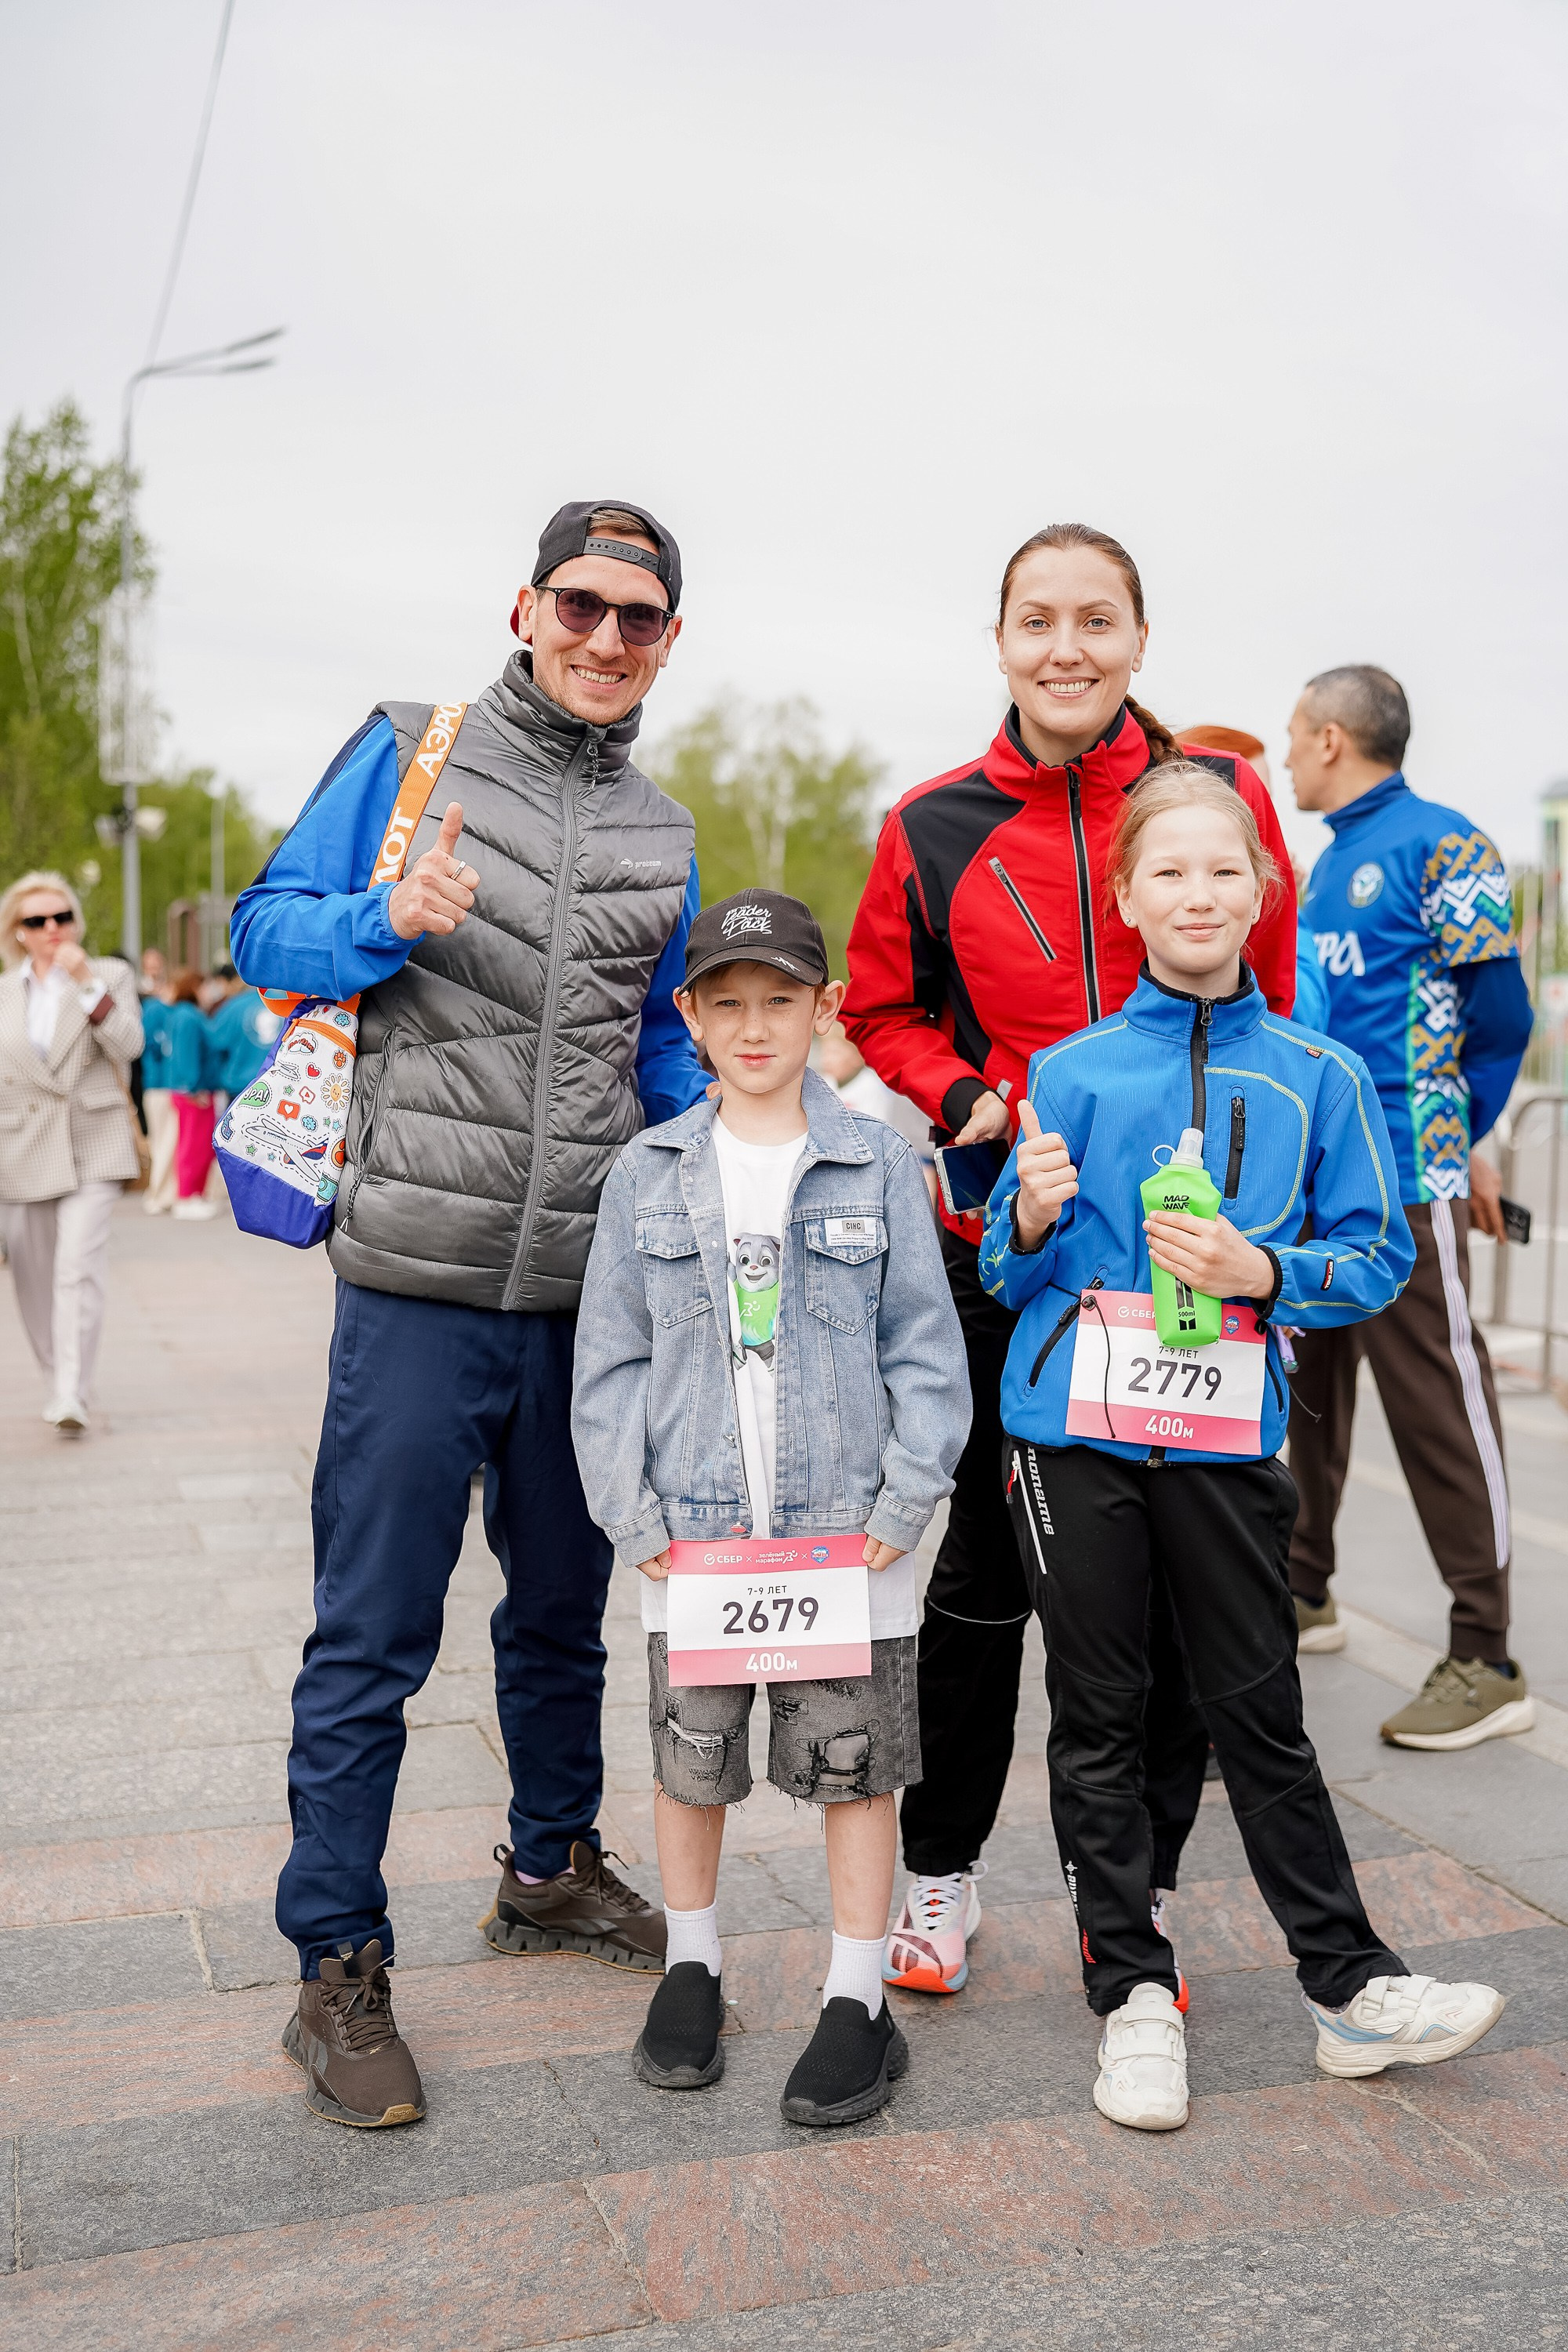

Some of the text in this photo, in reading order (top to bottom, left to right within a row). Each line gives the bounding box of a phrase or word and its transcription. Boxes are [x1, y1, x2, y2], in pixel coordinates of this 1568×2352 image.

[416, 700, 463, 779] АЭРО
[722, 916, 773, 940] Pack
[1159, 1345, 1199, 1359] 7-9 ЛЕТ
[1127, 1357, 1221, 1400] 2779
[1027, 1446, 1054, 1535] noname
[717, 1555, 743, 1563] СБЕР
[747, 1585, 787, 1595] 7-9 ЛЕТ
[722, 1597, 818, 1634] 2679
